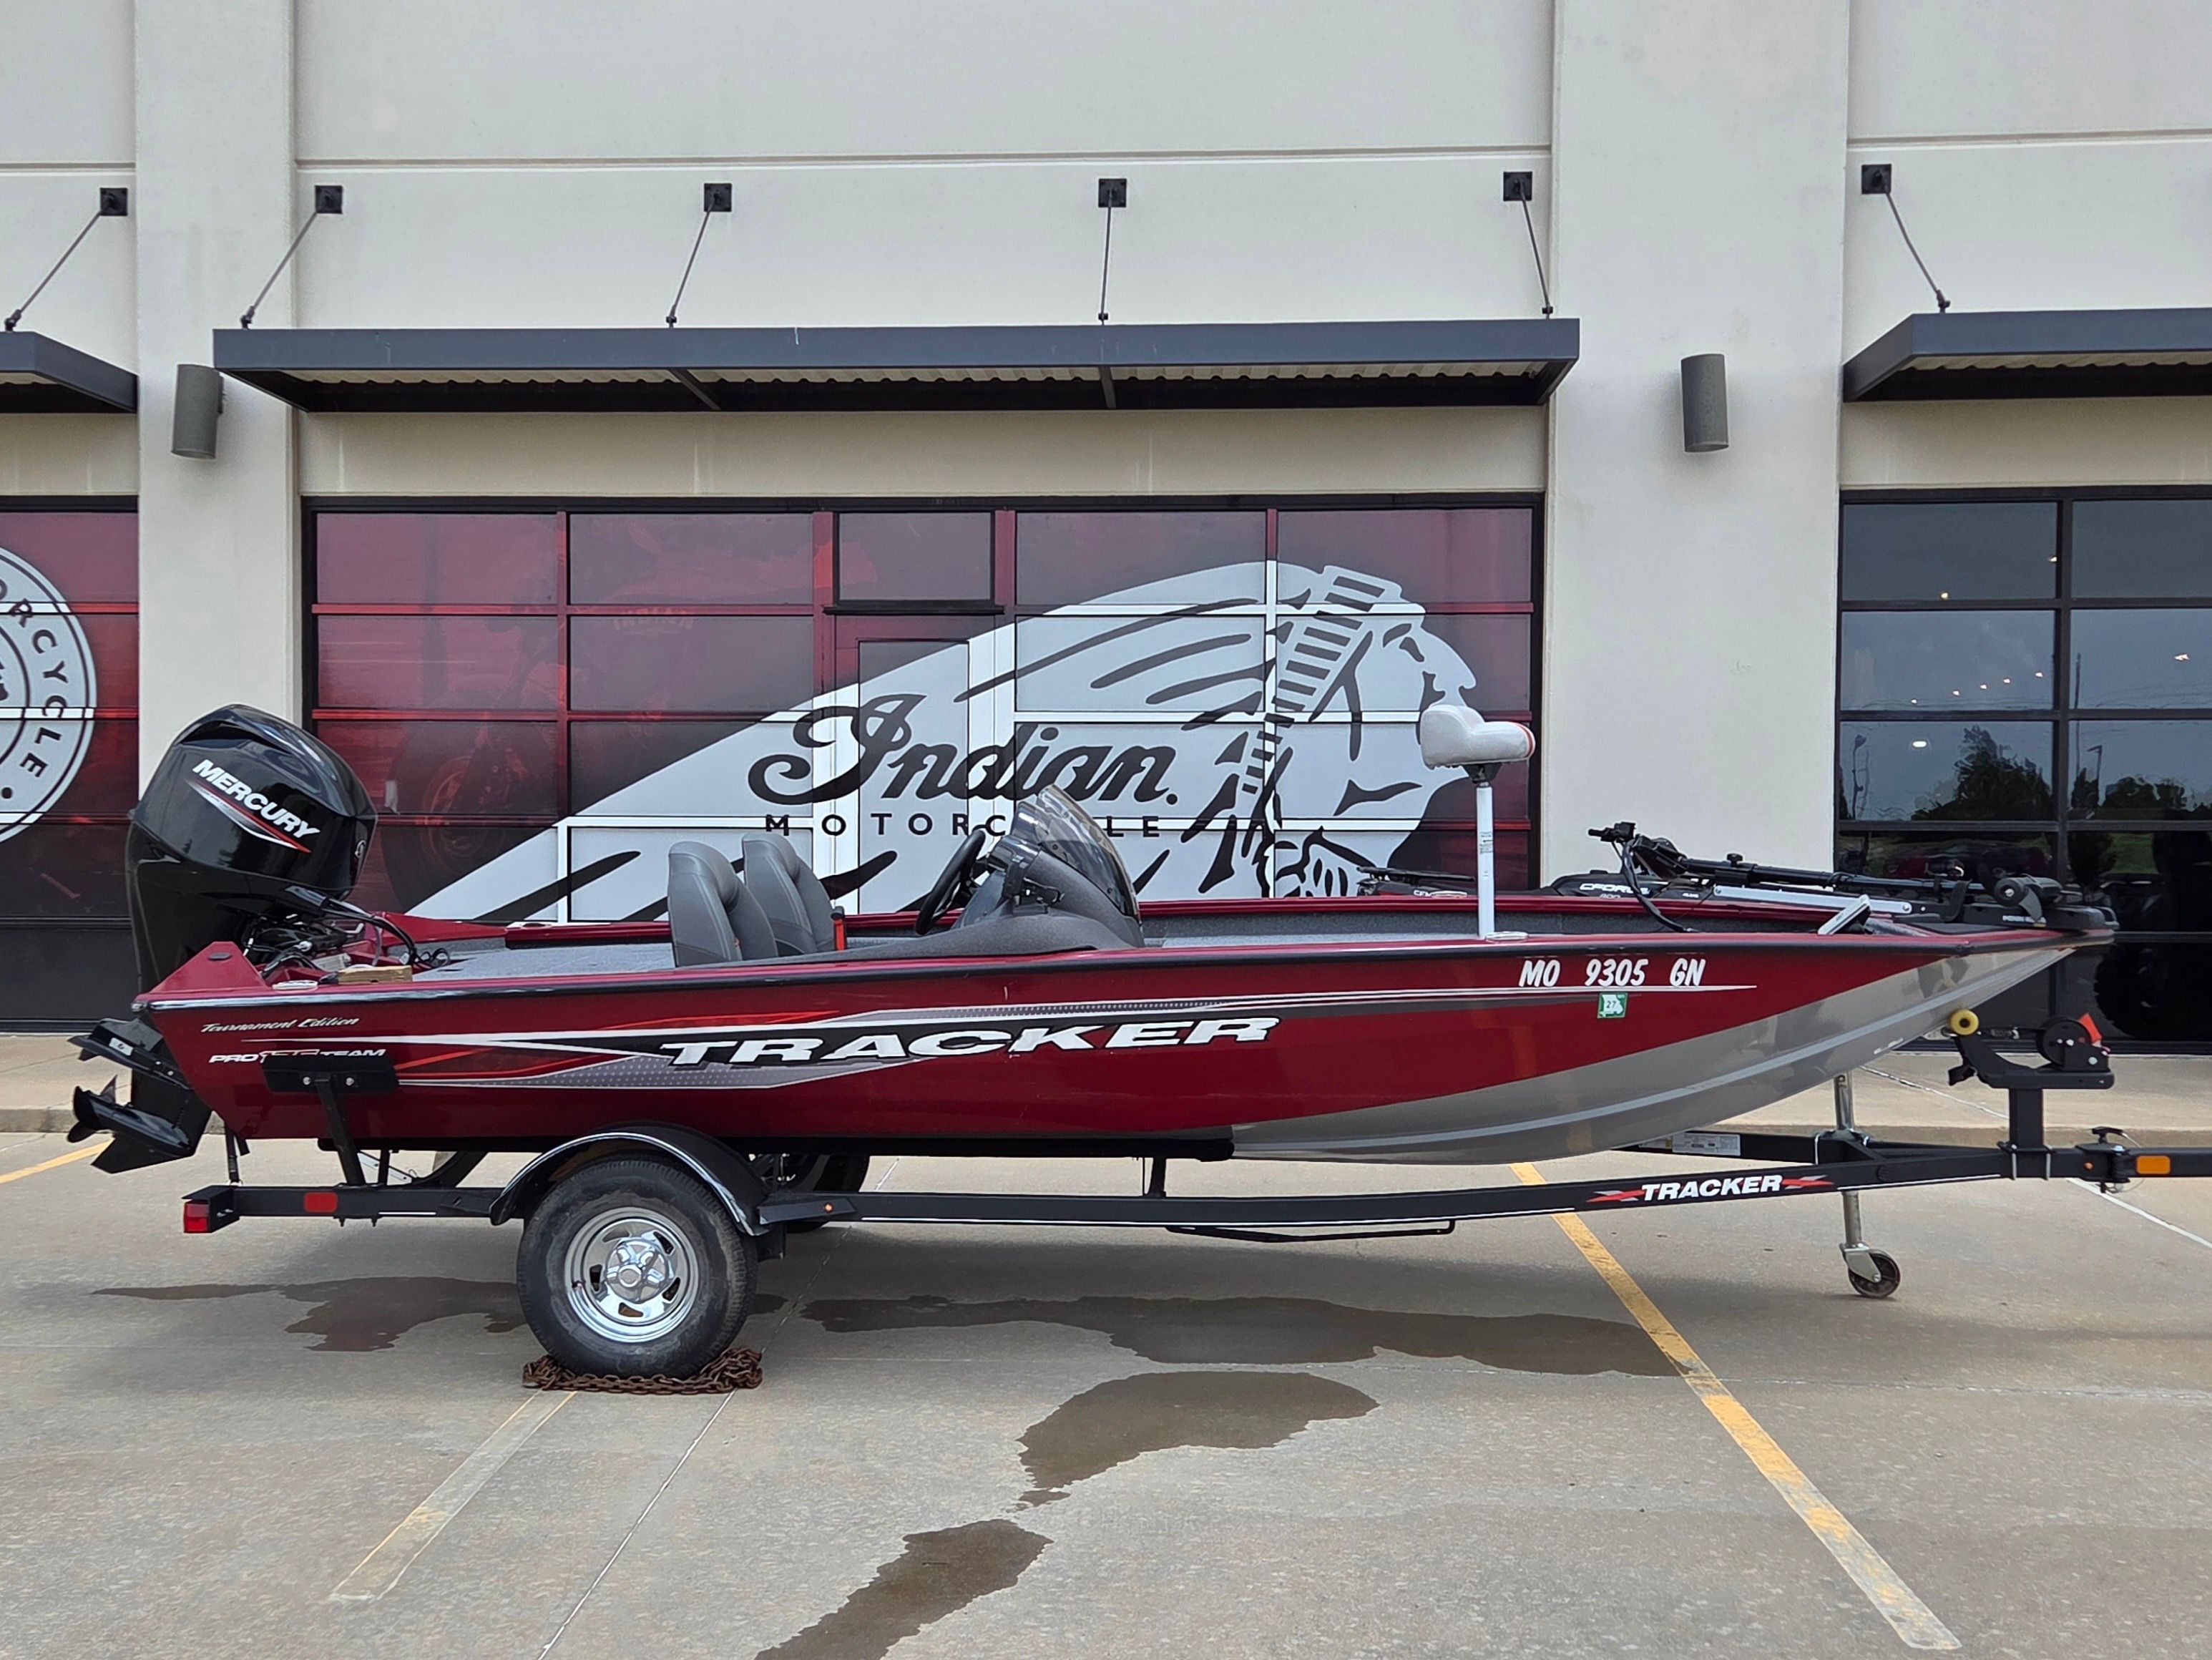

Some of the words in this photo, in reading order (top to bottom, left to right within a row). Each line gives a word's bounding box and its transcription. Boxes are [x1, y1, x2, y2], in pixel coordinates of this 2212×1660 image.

[192, 758, 320, 839] MERCURY
[765, 813, 1160, 837] MOTORCLE
[1518, 960, 1560, 987] MO
[1585, 958, 1648, 987] 9305
[1669, 958, 1706, 987] GN
[200, 1019, 298, 1032] Tournament
[298, 1017, 359, 1028] Edition
[660, 1016, 1281, 1068] TRACKER
[209, 1054, 260, 1063] PRO
[1641, 1174, 1783, 1201] TRACKER
